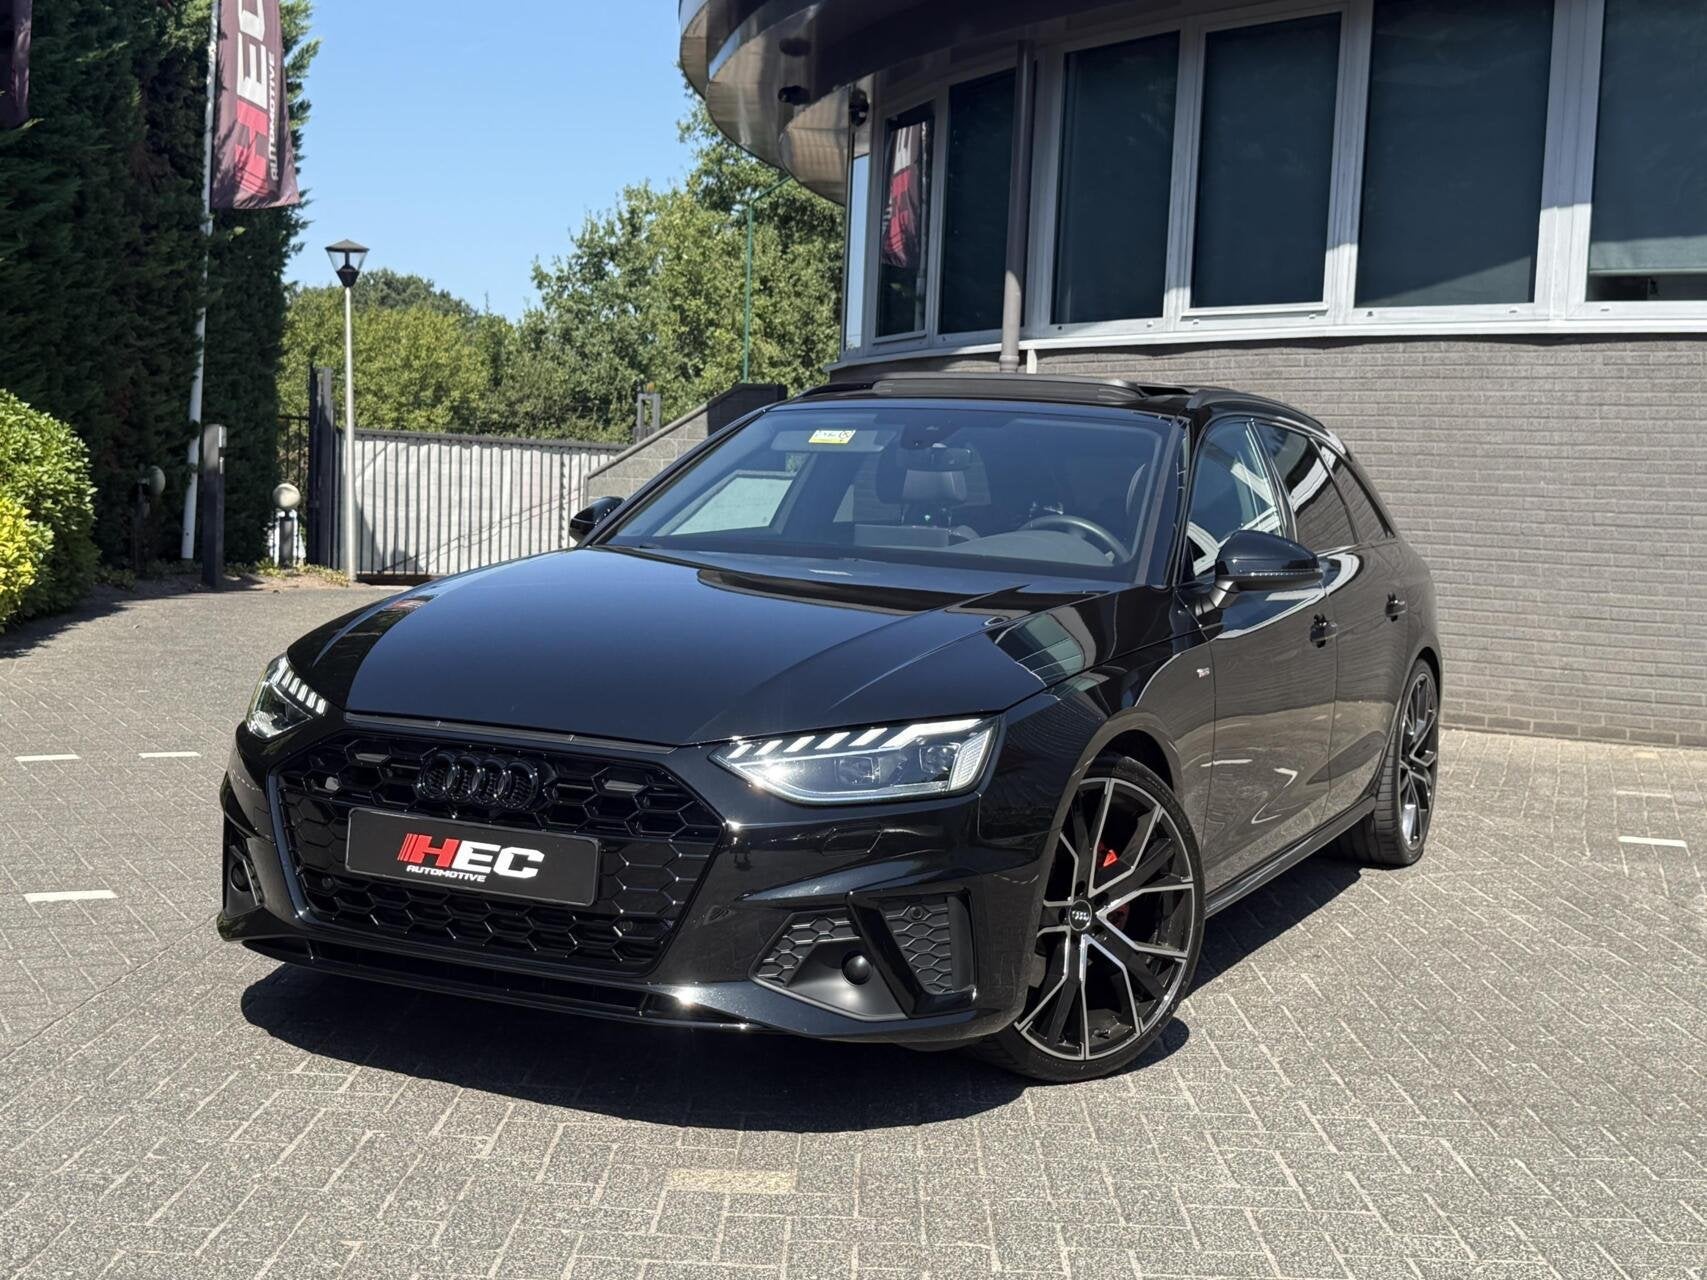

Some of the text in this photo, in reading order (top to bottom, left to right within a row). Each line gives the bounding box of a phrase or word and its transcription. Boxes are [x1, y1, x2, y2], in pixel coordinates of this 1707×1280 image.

[268, 52, 279, 181] AUTOMOTIVE
[397, 833, 545, 879] HEC
[406, 864, 487, 883] AUTOMOTIVE
